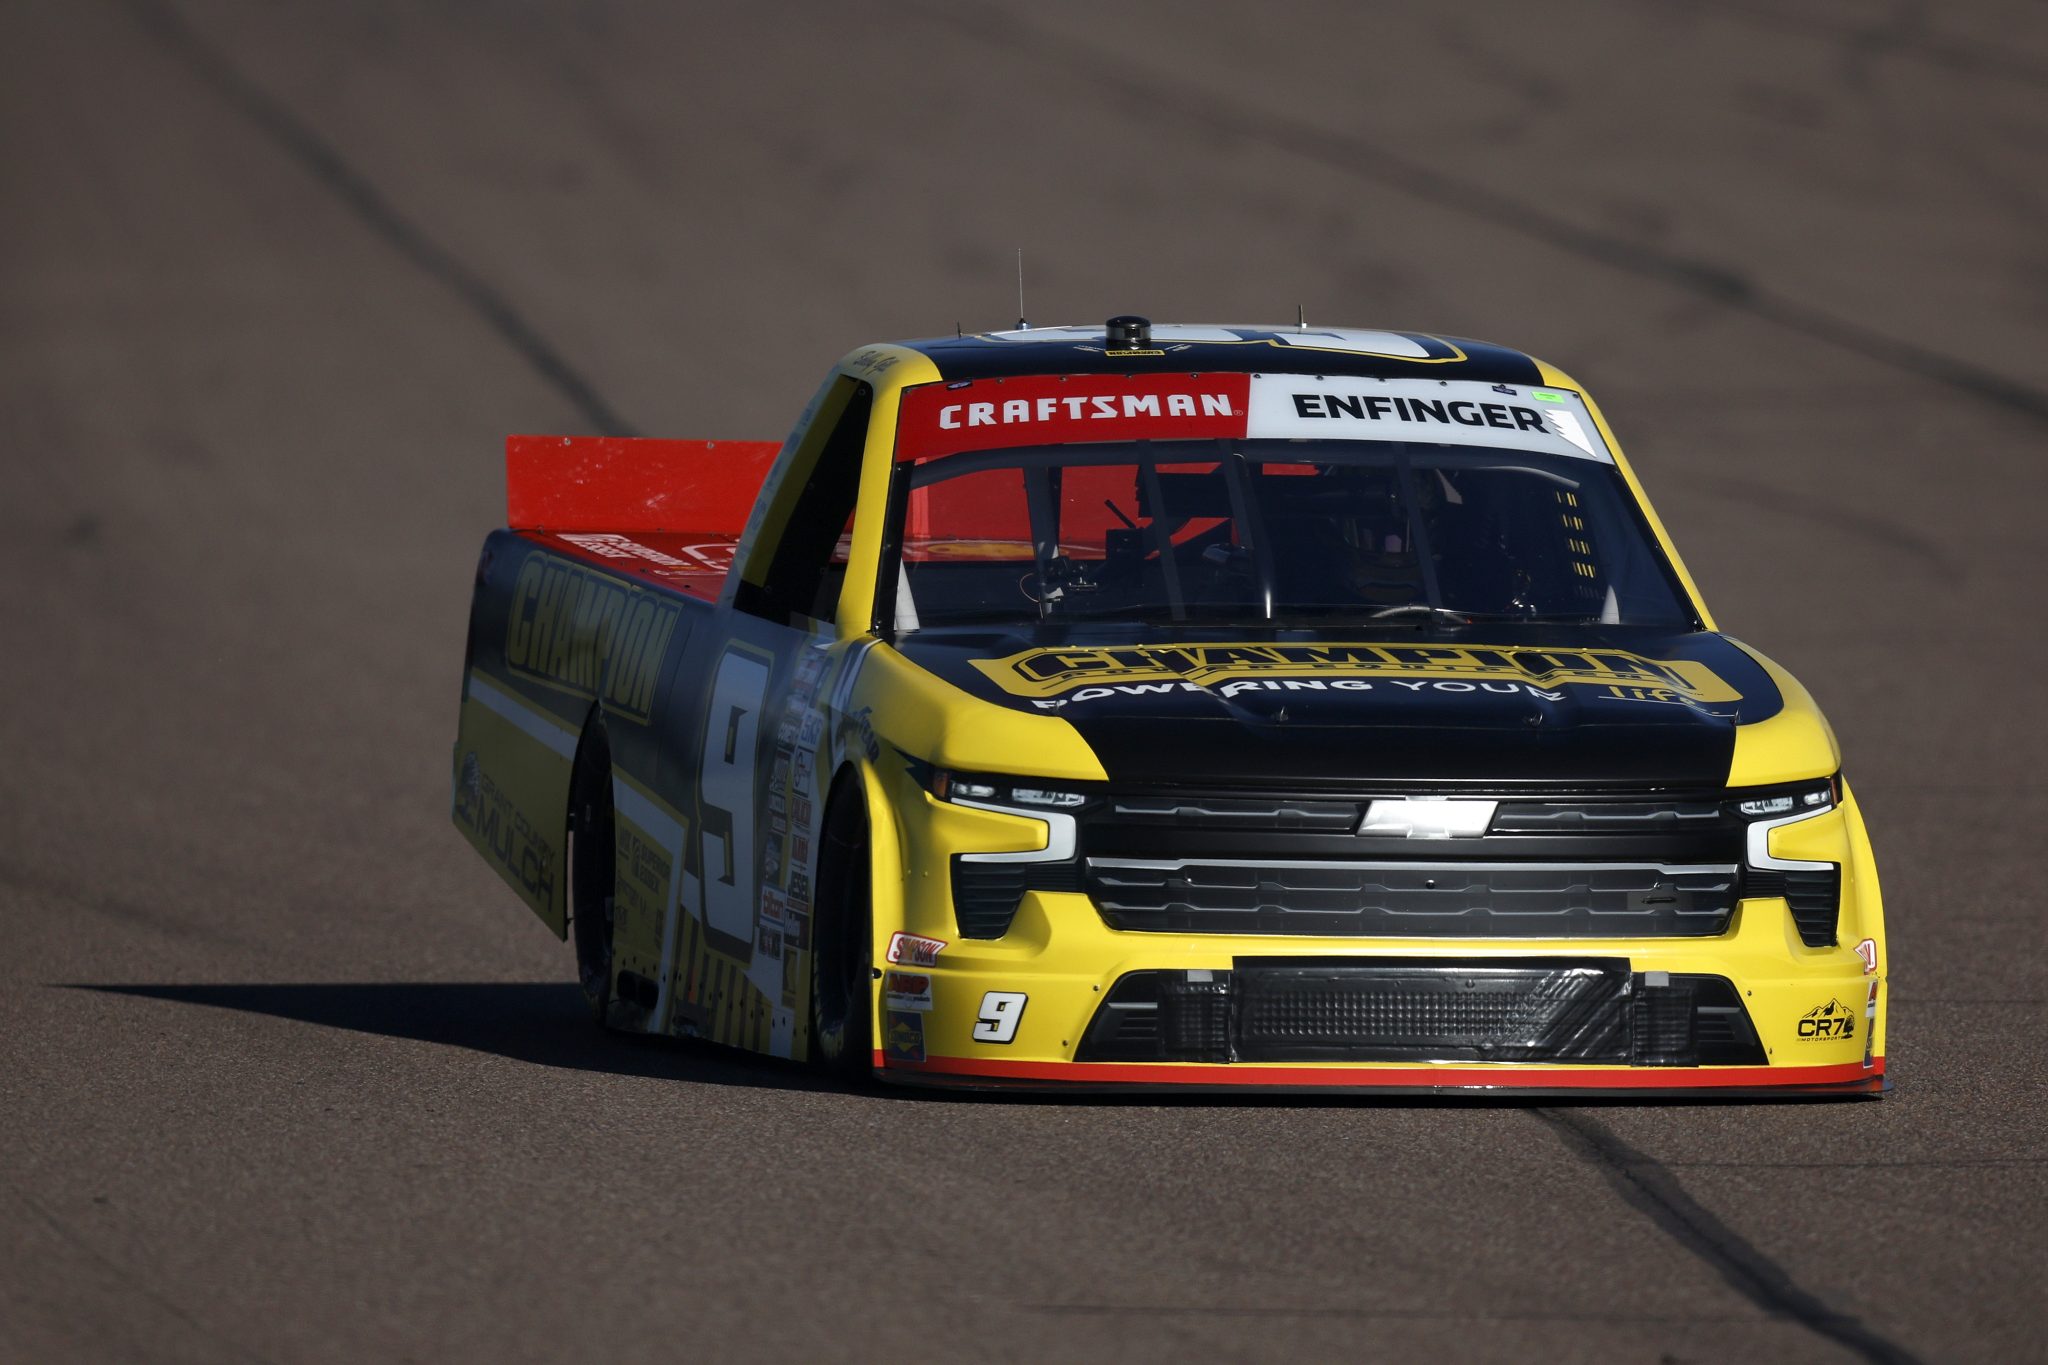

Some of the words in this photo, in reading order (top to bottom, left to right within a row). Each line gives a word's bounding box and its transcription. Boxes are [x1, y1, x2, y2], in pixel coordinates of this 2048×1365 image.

[939, 394, 1232, 430] CRAFTSMAN
[1292, 394, 1550, 434] ENFINGER
[507, 557, 678, 715] CHAMPION
[1016, 647, 1698, 690] CHAMPION
[1031, 680, 1374, 709] POWERING
[1390, 680, 1567, 702] YOUR
[700, 648, 772, 950] 9
[475, 793, 555, 913] MULCH
[971, 990, 1029, 1044] 9
[1797, 1018, 1845, 1037] CR7
